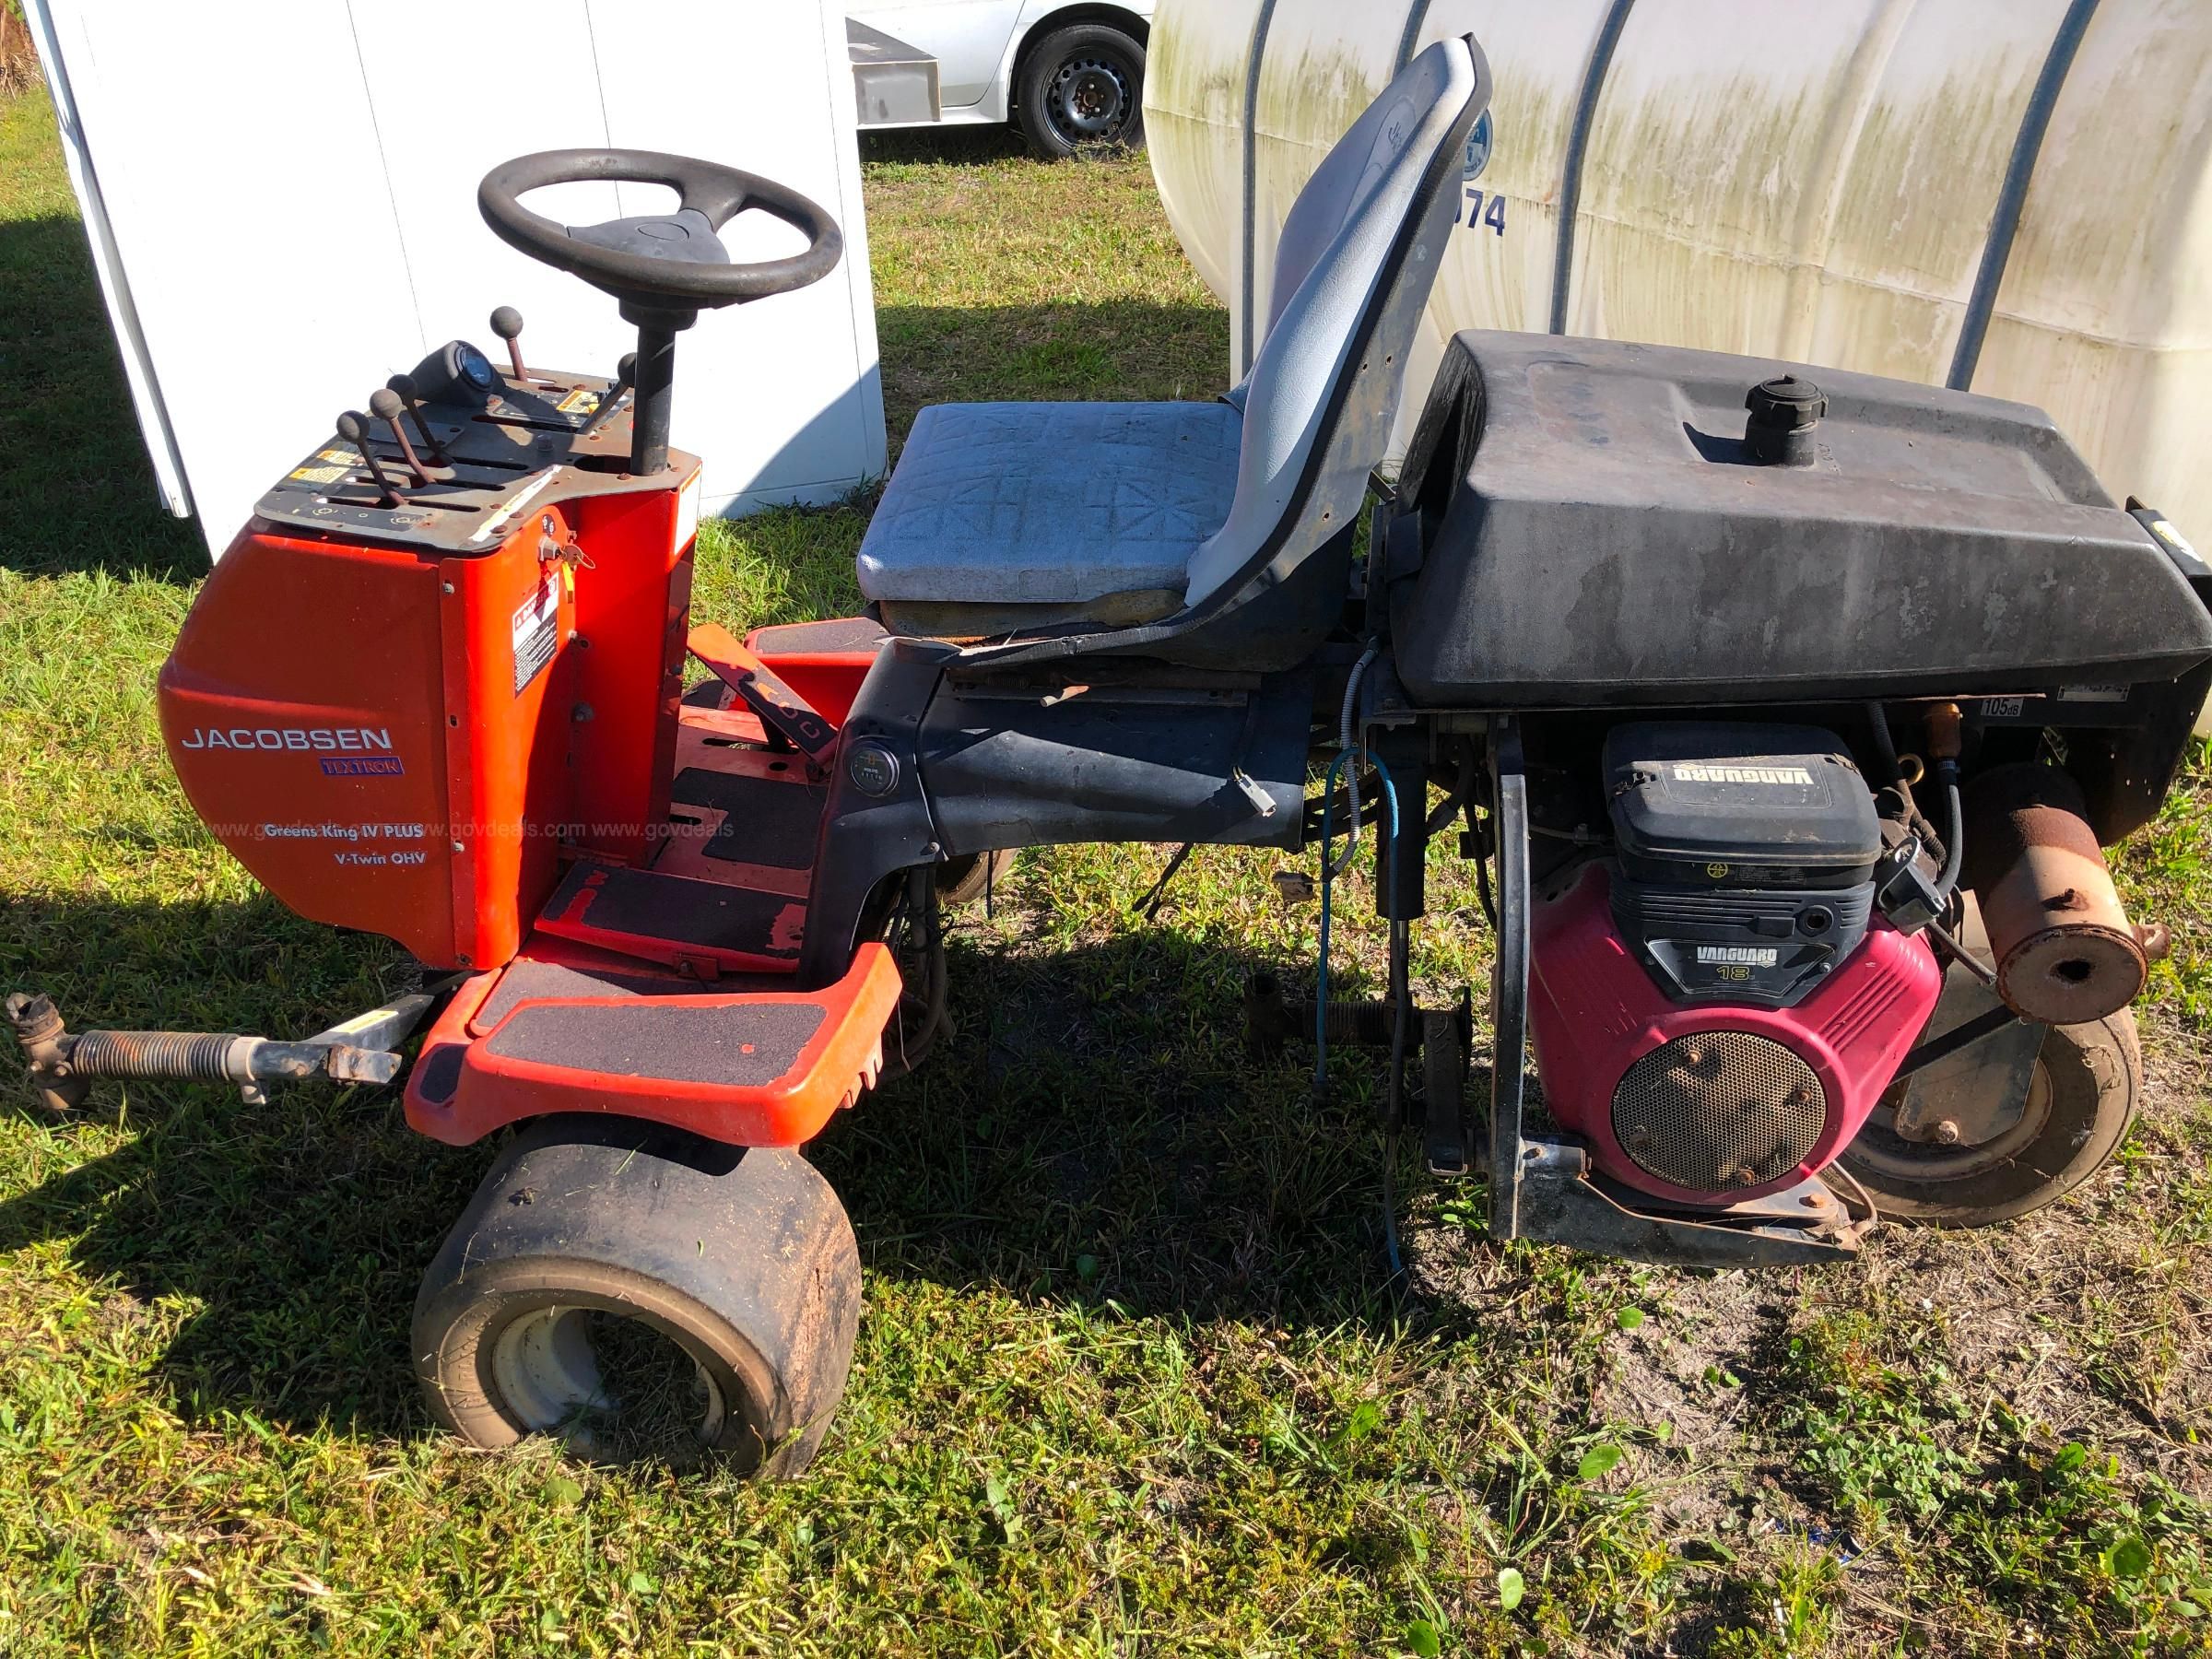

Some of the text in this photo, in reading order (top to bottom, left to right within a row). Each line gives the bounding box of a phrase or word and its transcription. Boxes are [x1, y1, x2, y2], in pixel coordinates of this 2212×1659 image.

[1454, 188, 1505, 237] 74
[182, 728, 393, 749] JACOBSEN
[324, 758, 401, 774] TEXTRON
[1674, 769, 1815, 784] VANGUARD
[265, 823, 424, 841] Greens King IV PLUS
[335, 853, 426, 865] V-Twin OHV
[1697, 946, 1778, 962] VANGUARD
[1716, 965, 1749, 981] 18
